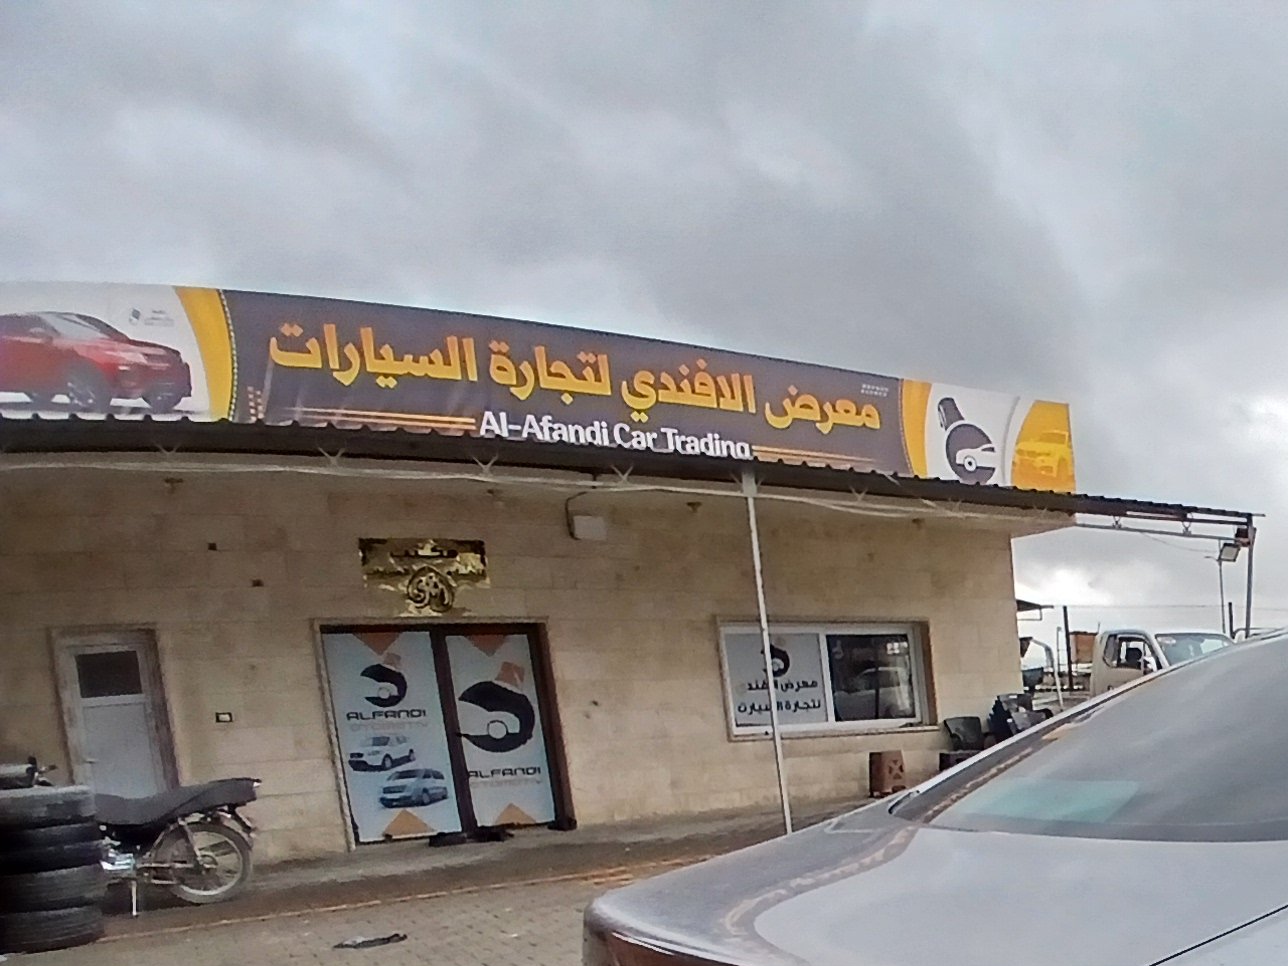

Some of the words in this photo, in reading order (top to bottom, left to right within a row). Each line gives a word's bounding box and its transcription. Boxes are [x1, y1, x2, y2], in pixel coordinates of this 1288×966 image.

[269, 322, 478, 389] السيارات
[489, 340, 612, 405] لتجارة
[621, 358, 756, 423] الافندي
[764, 384, 881, 435] معرض
[479, 410, 609, 447] Al-Afandi
[613, 422, 658, 450] Car
[661, 427, 753, 460] Trading
[346, 708, 427, 721] ALFANDI
